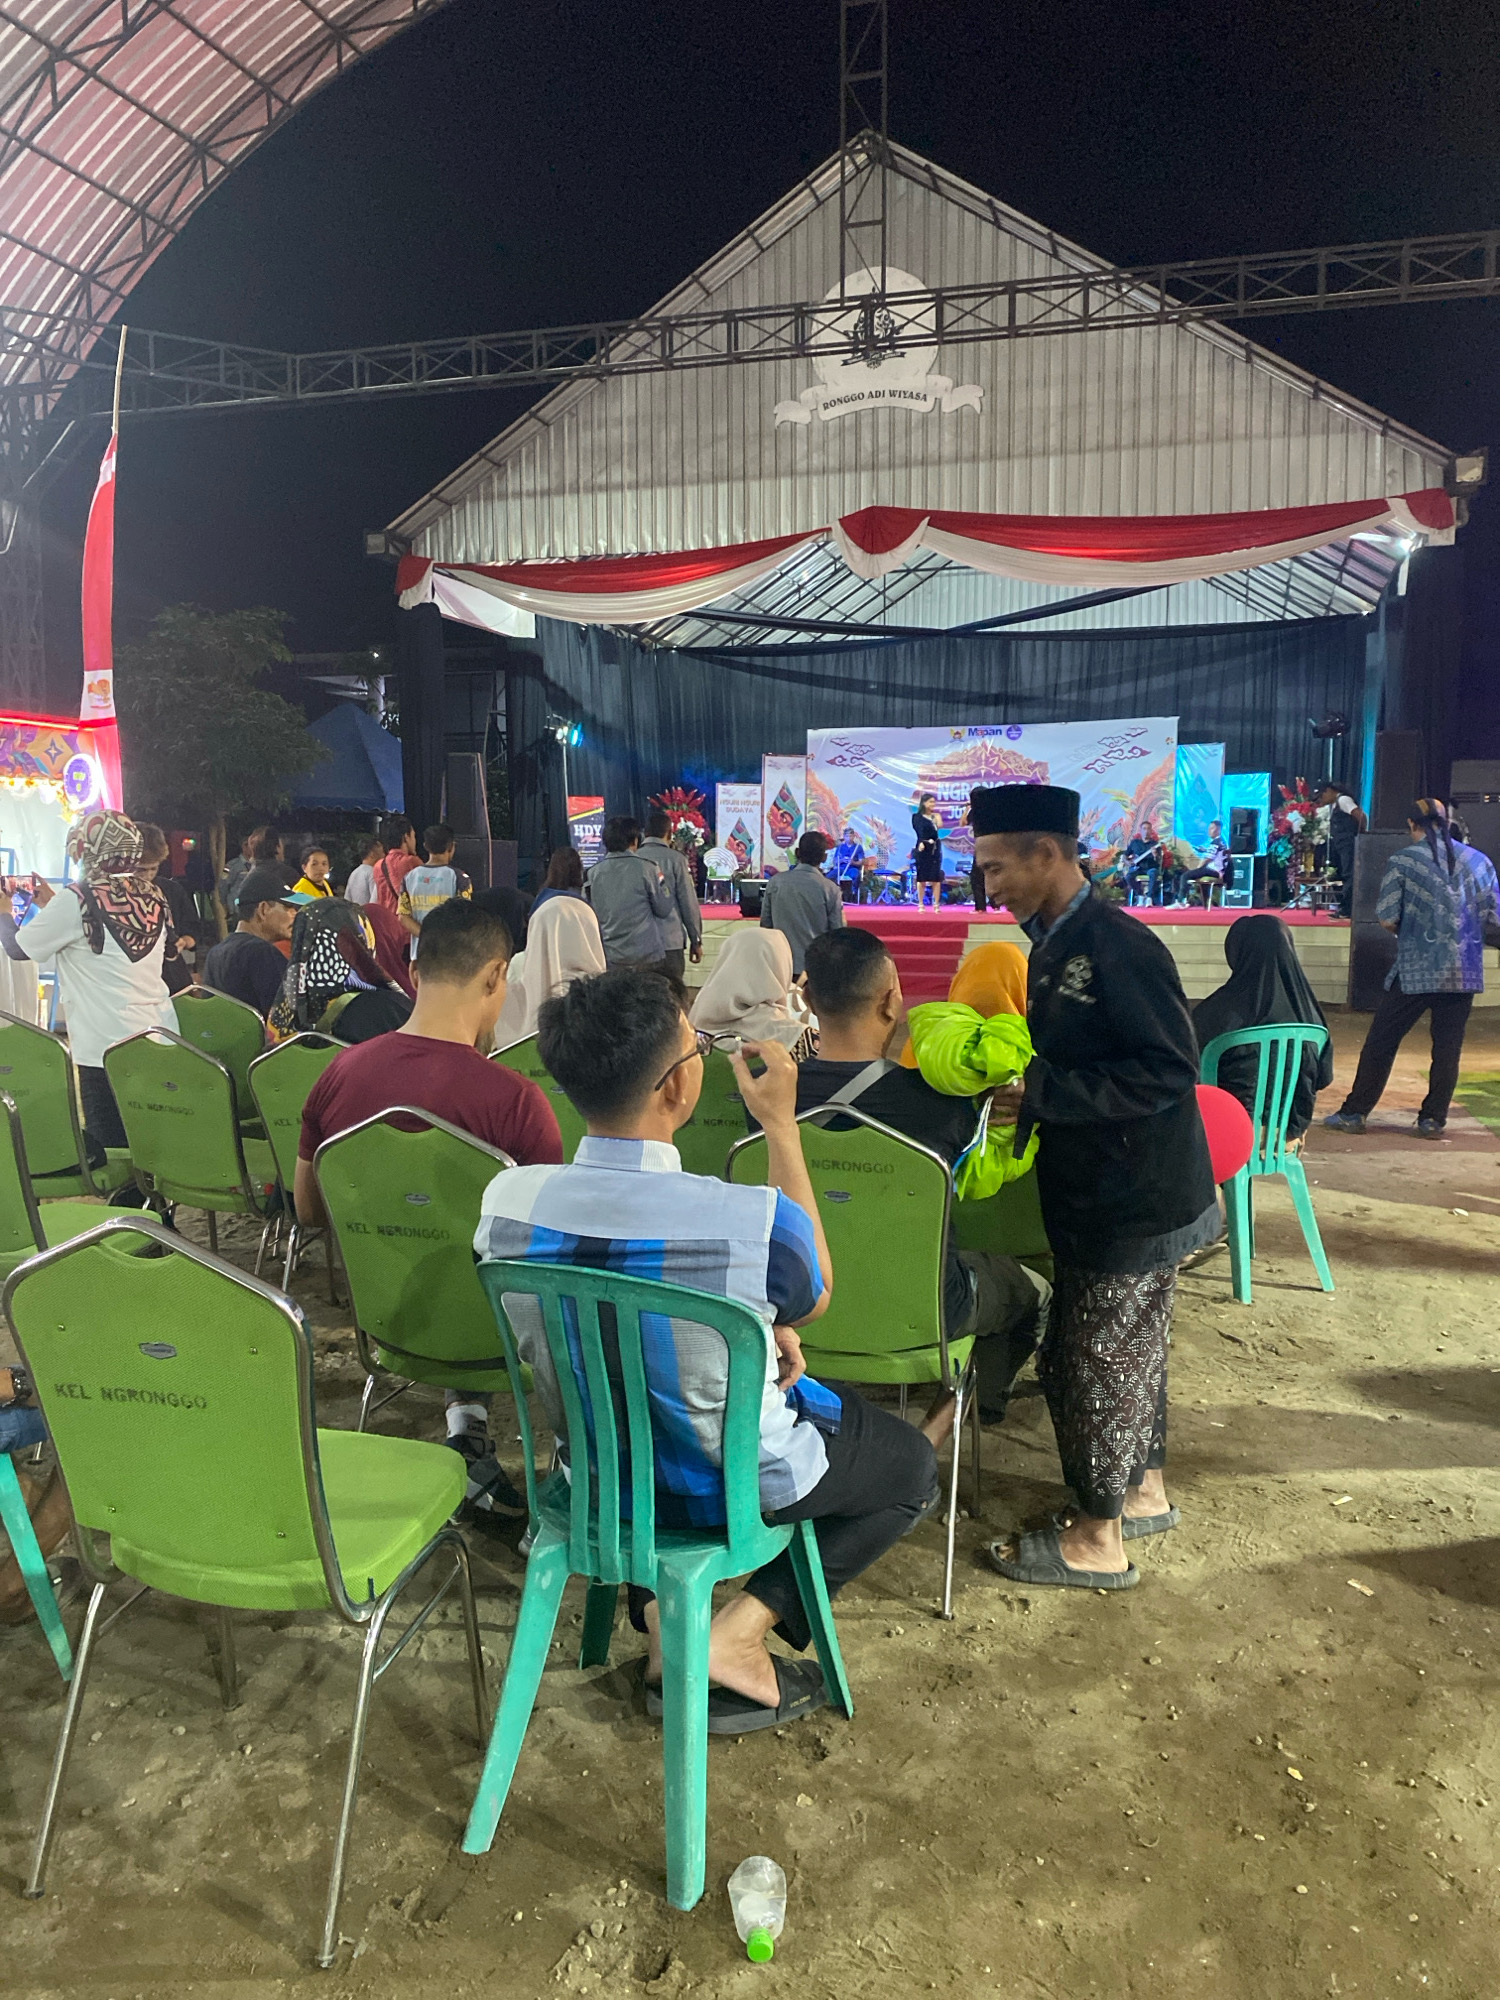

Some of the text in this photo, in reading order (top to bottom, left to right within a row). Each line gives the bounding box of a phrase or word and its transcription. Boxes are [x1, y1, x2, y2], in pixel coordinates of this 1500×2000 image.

[822, 389, 928, 411] RONGGO ADI WIYASA
[967, 727, 1003, 738] Mapan
[573, 824, 602, 836] HDY
[810, 1158, 895, 1174] NGRONGGO
[345, 1221, 451, 1241] KEL NGRONGGO
[54, 1383, 208, 1409] KEL NGRONGGO
